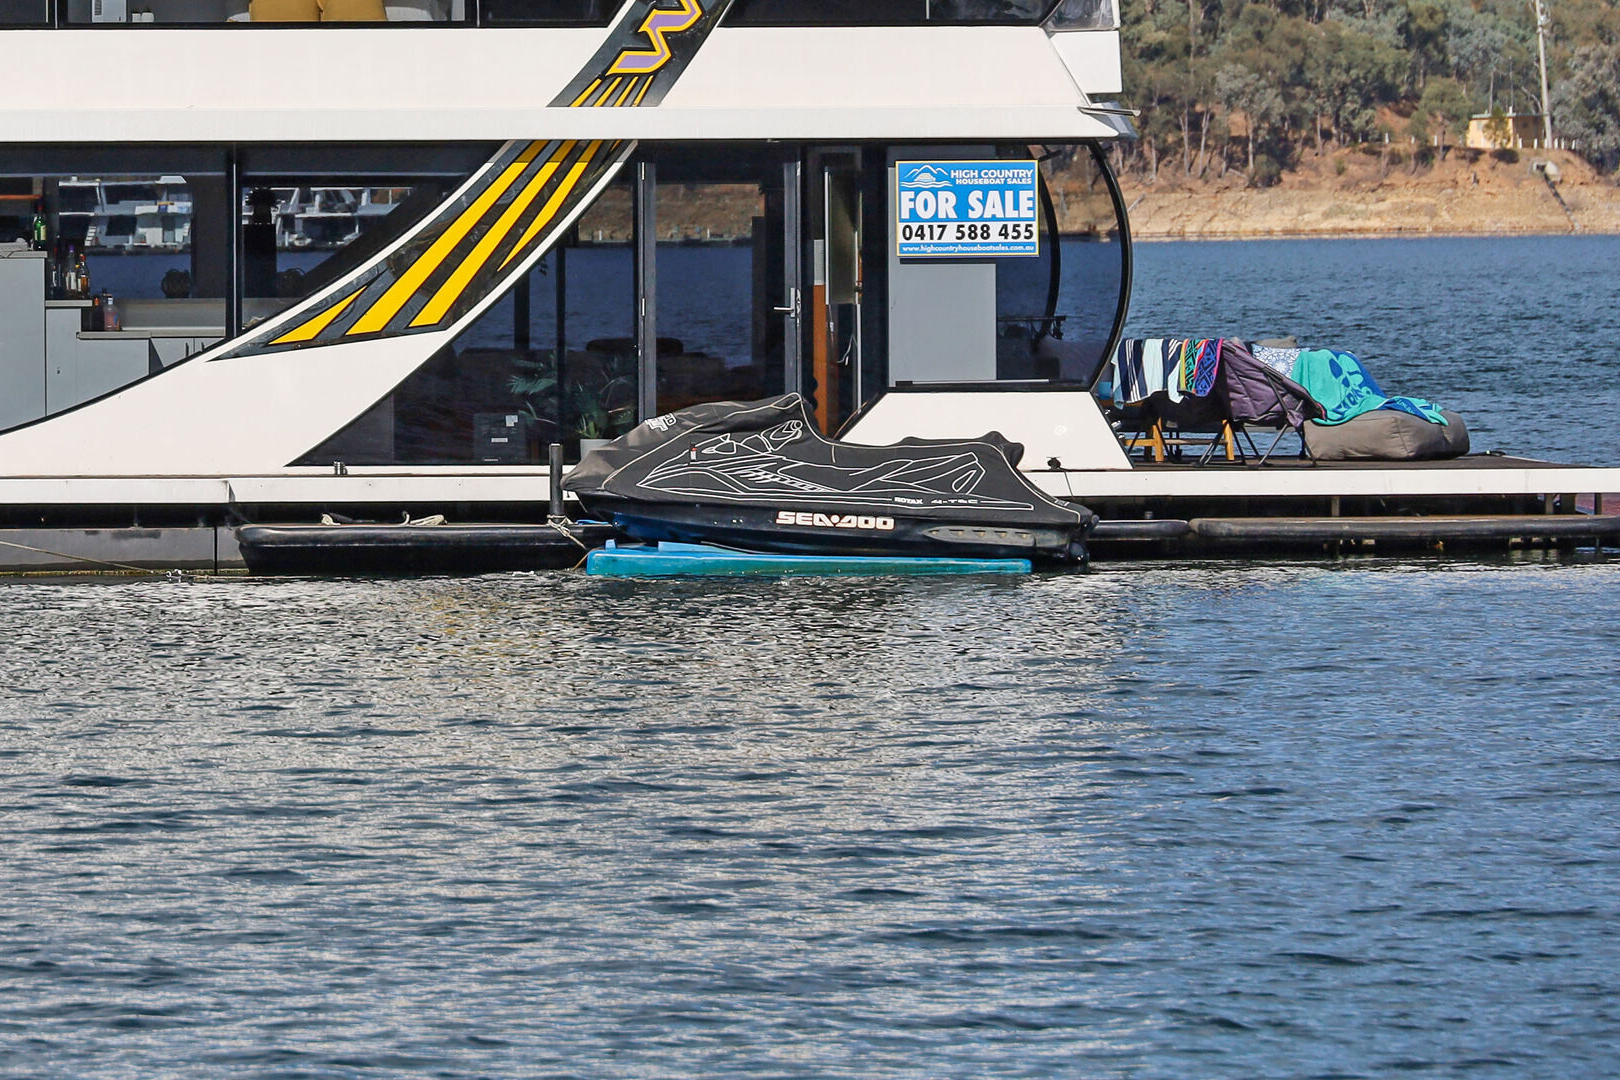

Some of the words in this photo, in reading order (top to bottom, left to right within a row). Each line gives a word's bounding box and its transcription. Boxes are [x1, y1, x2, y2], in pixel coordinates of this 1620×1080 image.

[950, 169, 979, 179] HIGH
[981, 169, 1034, 179] COUNTRY
[900, 190, 958, 220] FOR
[968, 190, 1034, 219] SALE
[902, 224, 948, 241] 0417
[955, 223, 991, 241] 588
[998, 223, 1034, 240] 455
[902, 244, 1035, 253] www.highcountryhouseboatsales.com.au
[894, 497, 923, 505] ROTAX
